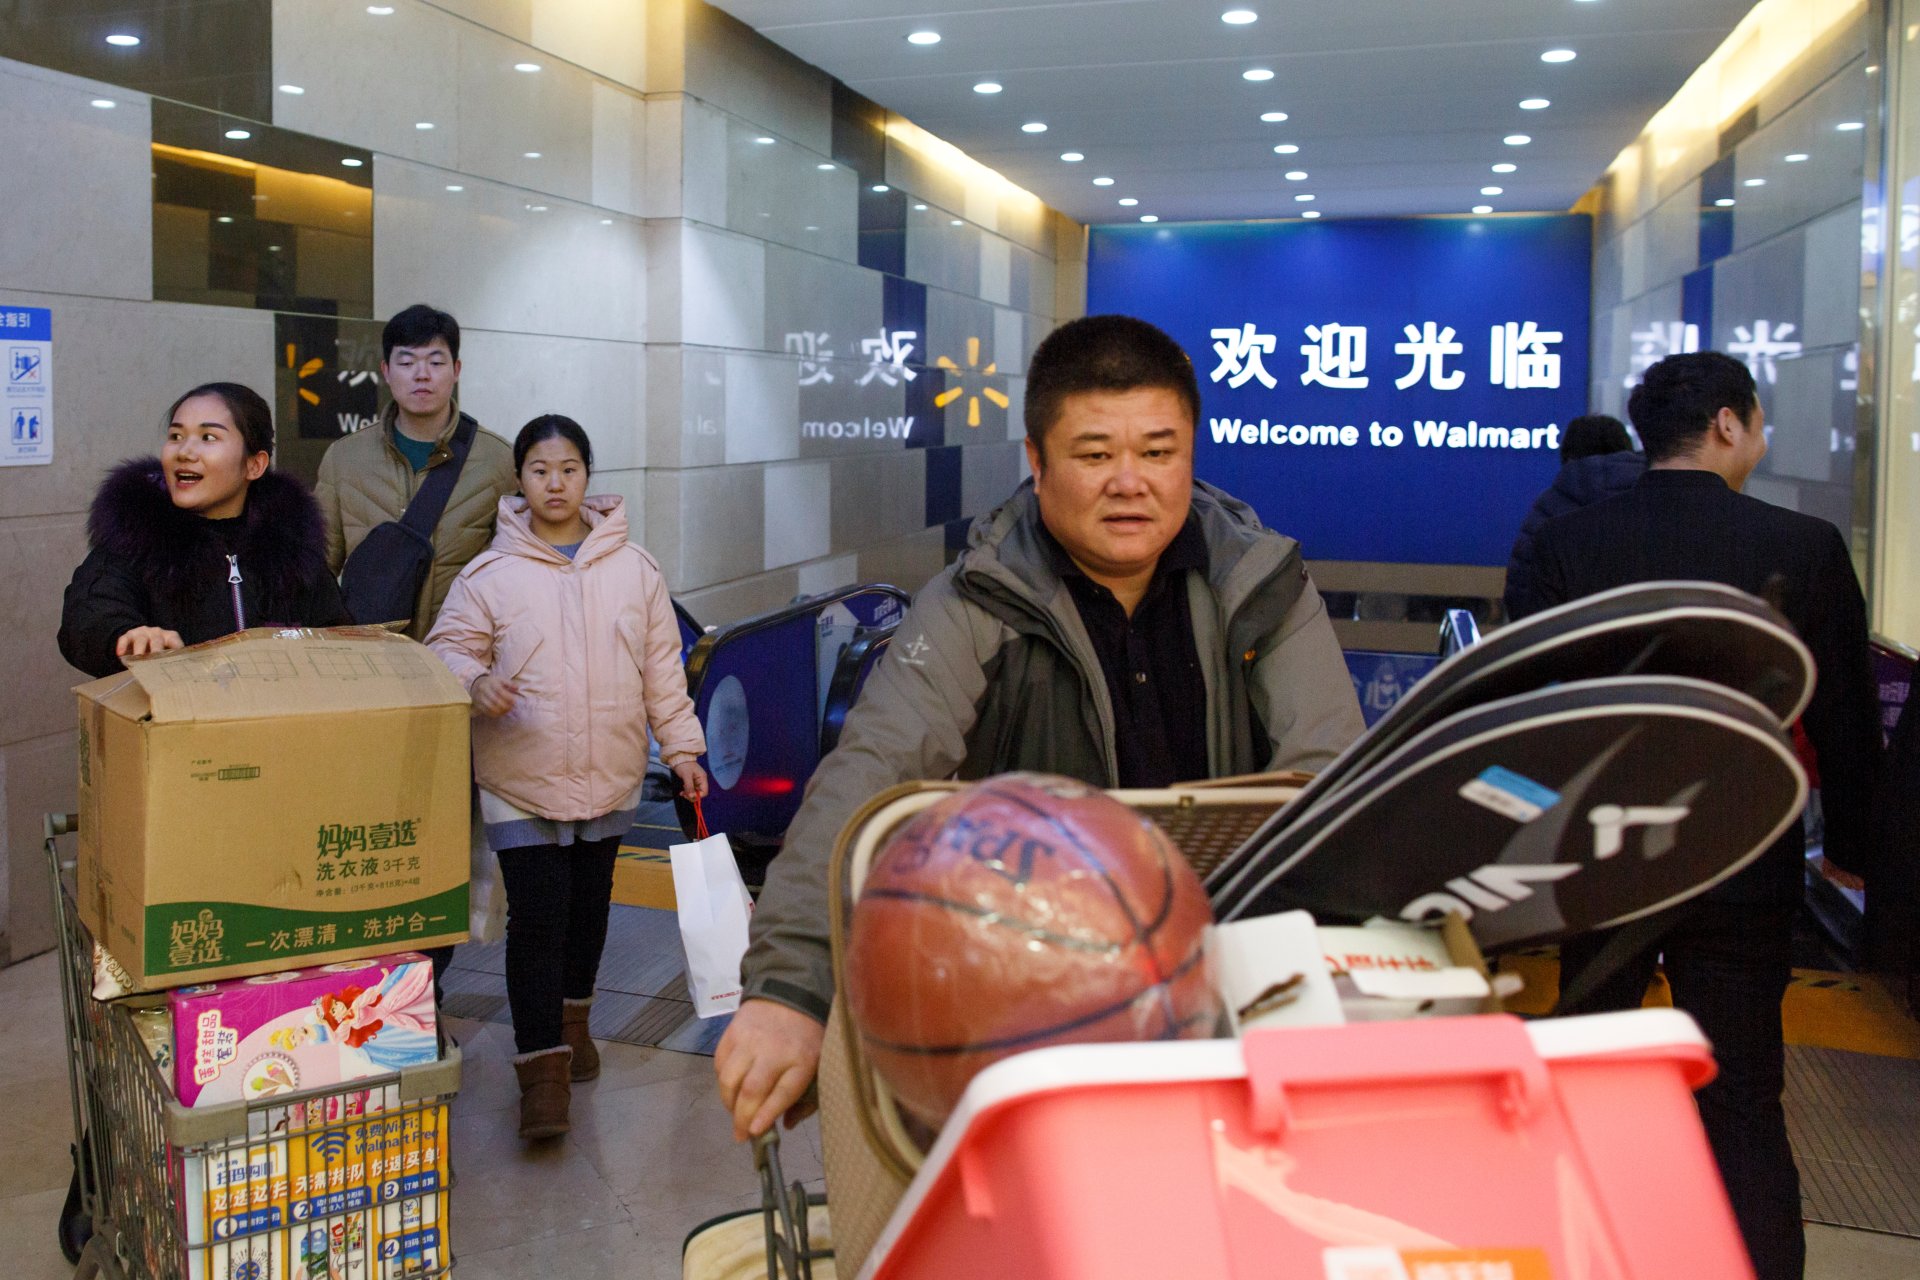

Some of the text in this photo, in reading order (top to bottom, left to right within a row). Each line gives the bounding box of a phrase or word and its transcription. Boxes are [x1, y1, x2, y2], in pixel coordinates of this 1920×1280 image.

[1210, 321, 1563, 390] 欢迎光临
[1210, 418, 1561, 450] Welcome to Walmart
[316, 819, 418, 860] 妈妈壹选
[355, 1131, 409, 1155] Walmat
[385, 1183, 395, 1198] 3
[299, 1203, 309, 1218] 2
[385, 1241, 395, 1255] 4
